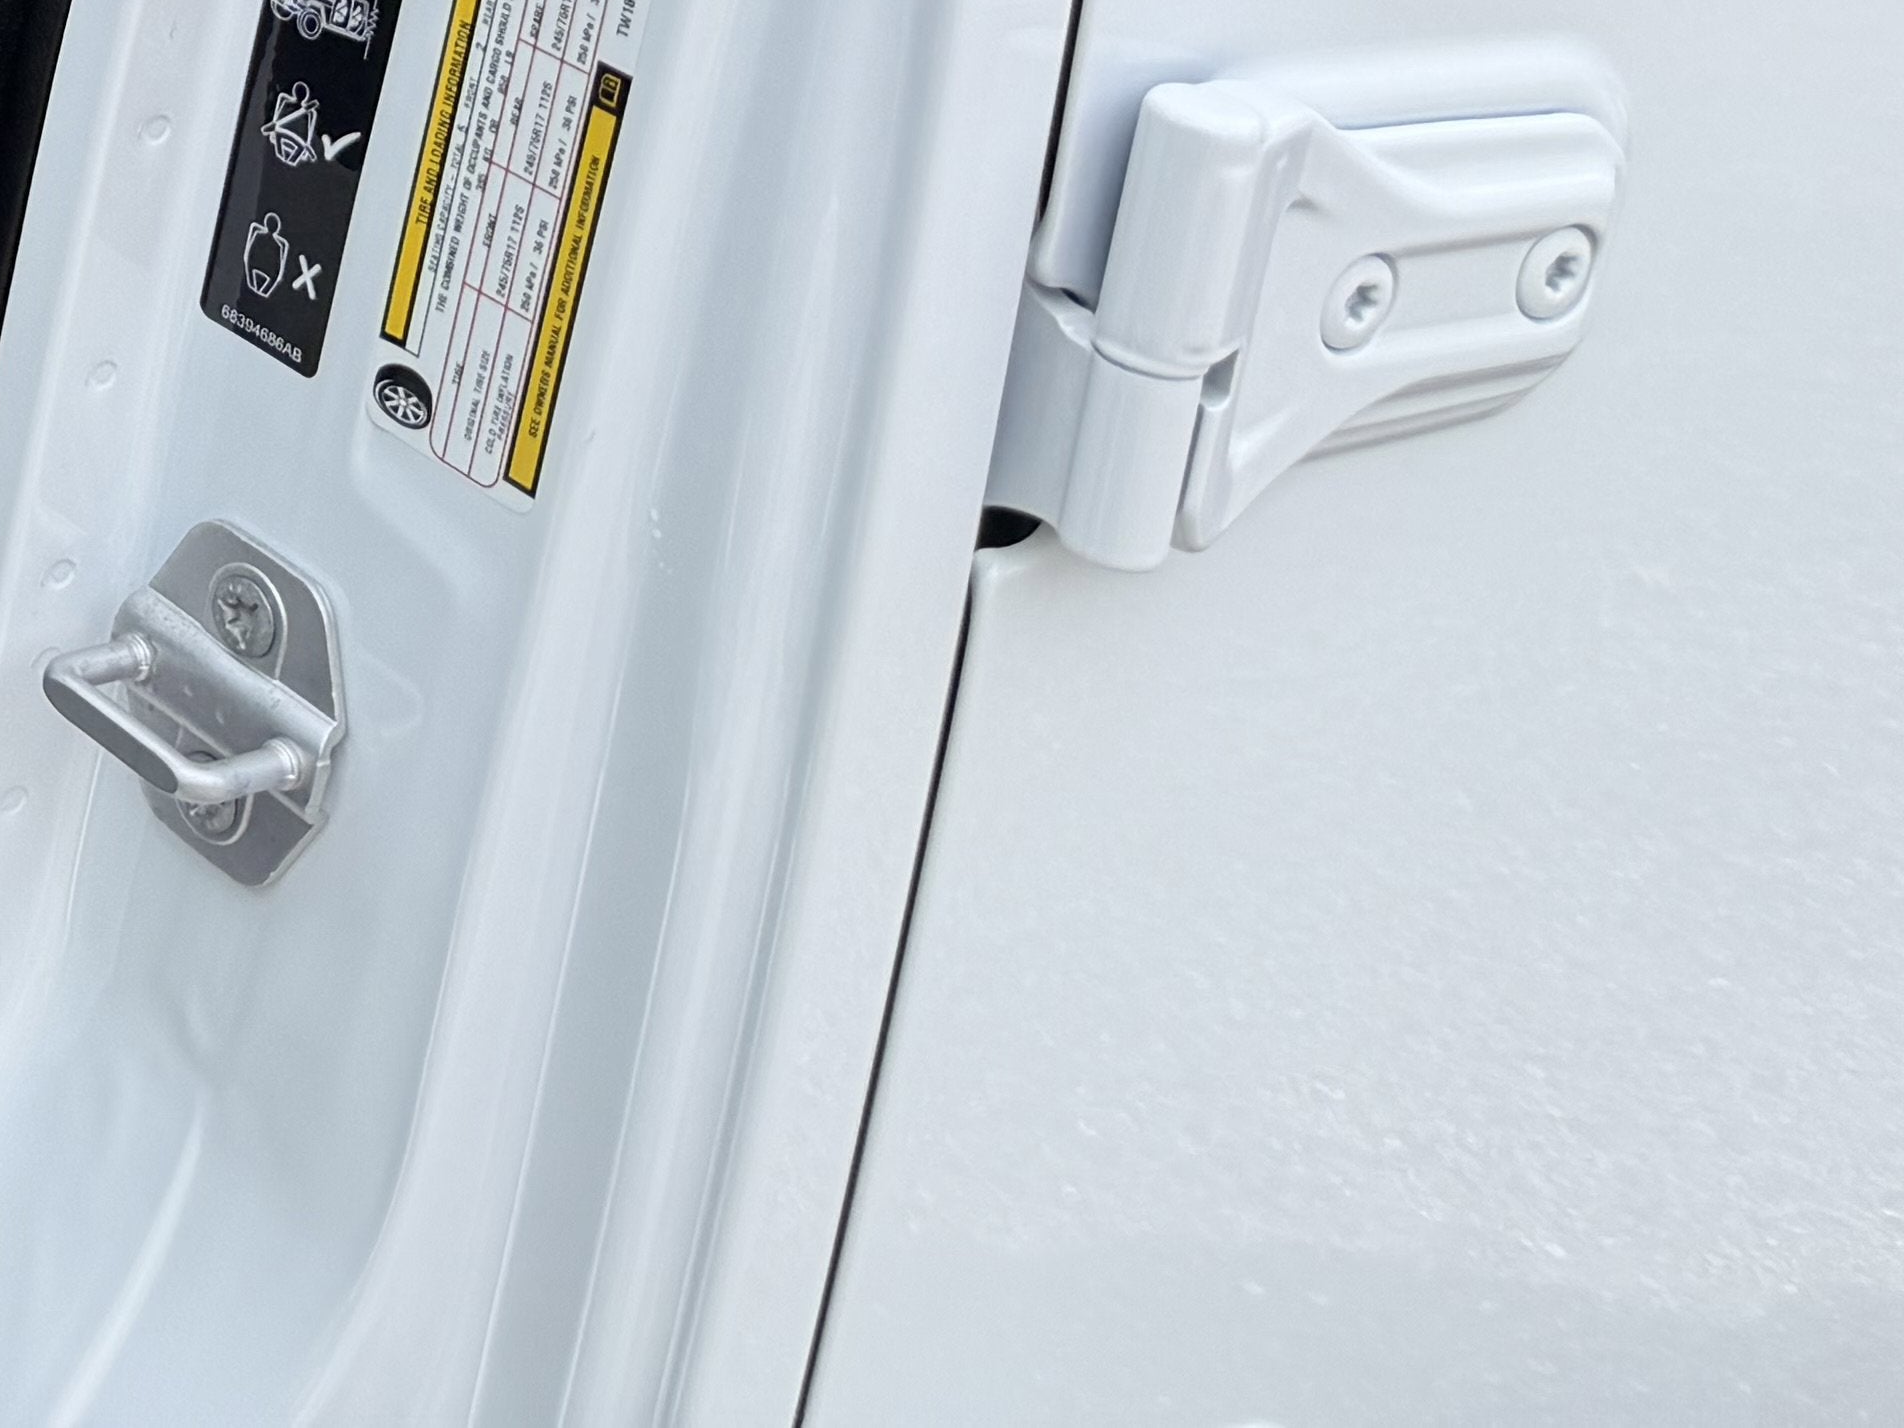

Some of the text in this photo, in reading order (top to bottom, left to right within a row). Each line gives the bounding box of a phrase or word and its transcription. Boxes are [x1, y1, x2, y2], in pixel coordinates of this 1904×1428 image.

[493, 1, 512, 46] SHOULD
[485, 45, 502, 85] CARGO
[479, 84, 494, 110] AND
[563, 93, 577, 115] PSI
[415, 18, 472, 228] TIRE AND LOADING INFORMATION
[465, 110, 488, 175] OCCUPANTS
[461, 175, 474, 191] OF
[452, 191, 470, 234] WEIGHT
[535, 217, 548, 239] PSI
[439, 234, 461, 291] COMBINED
[559, 230, 583, 296] ADDITIONAL
[434, 291, 448, 314] THE
[553, 296, 568, 321] FOR
[543, 322, 563, 370] MANUAL
[527, 416, 542, 440] SEE
